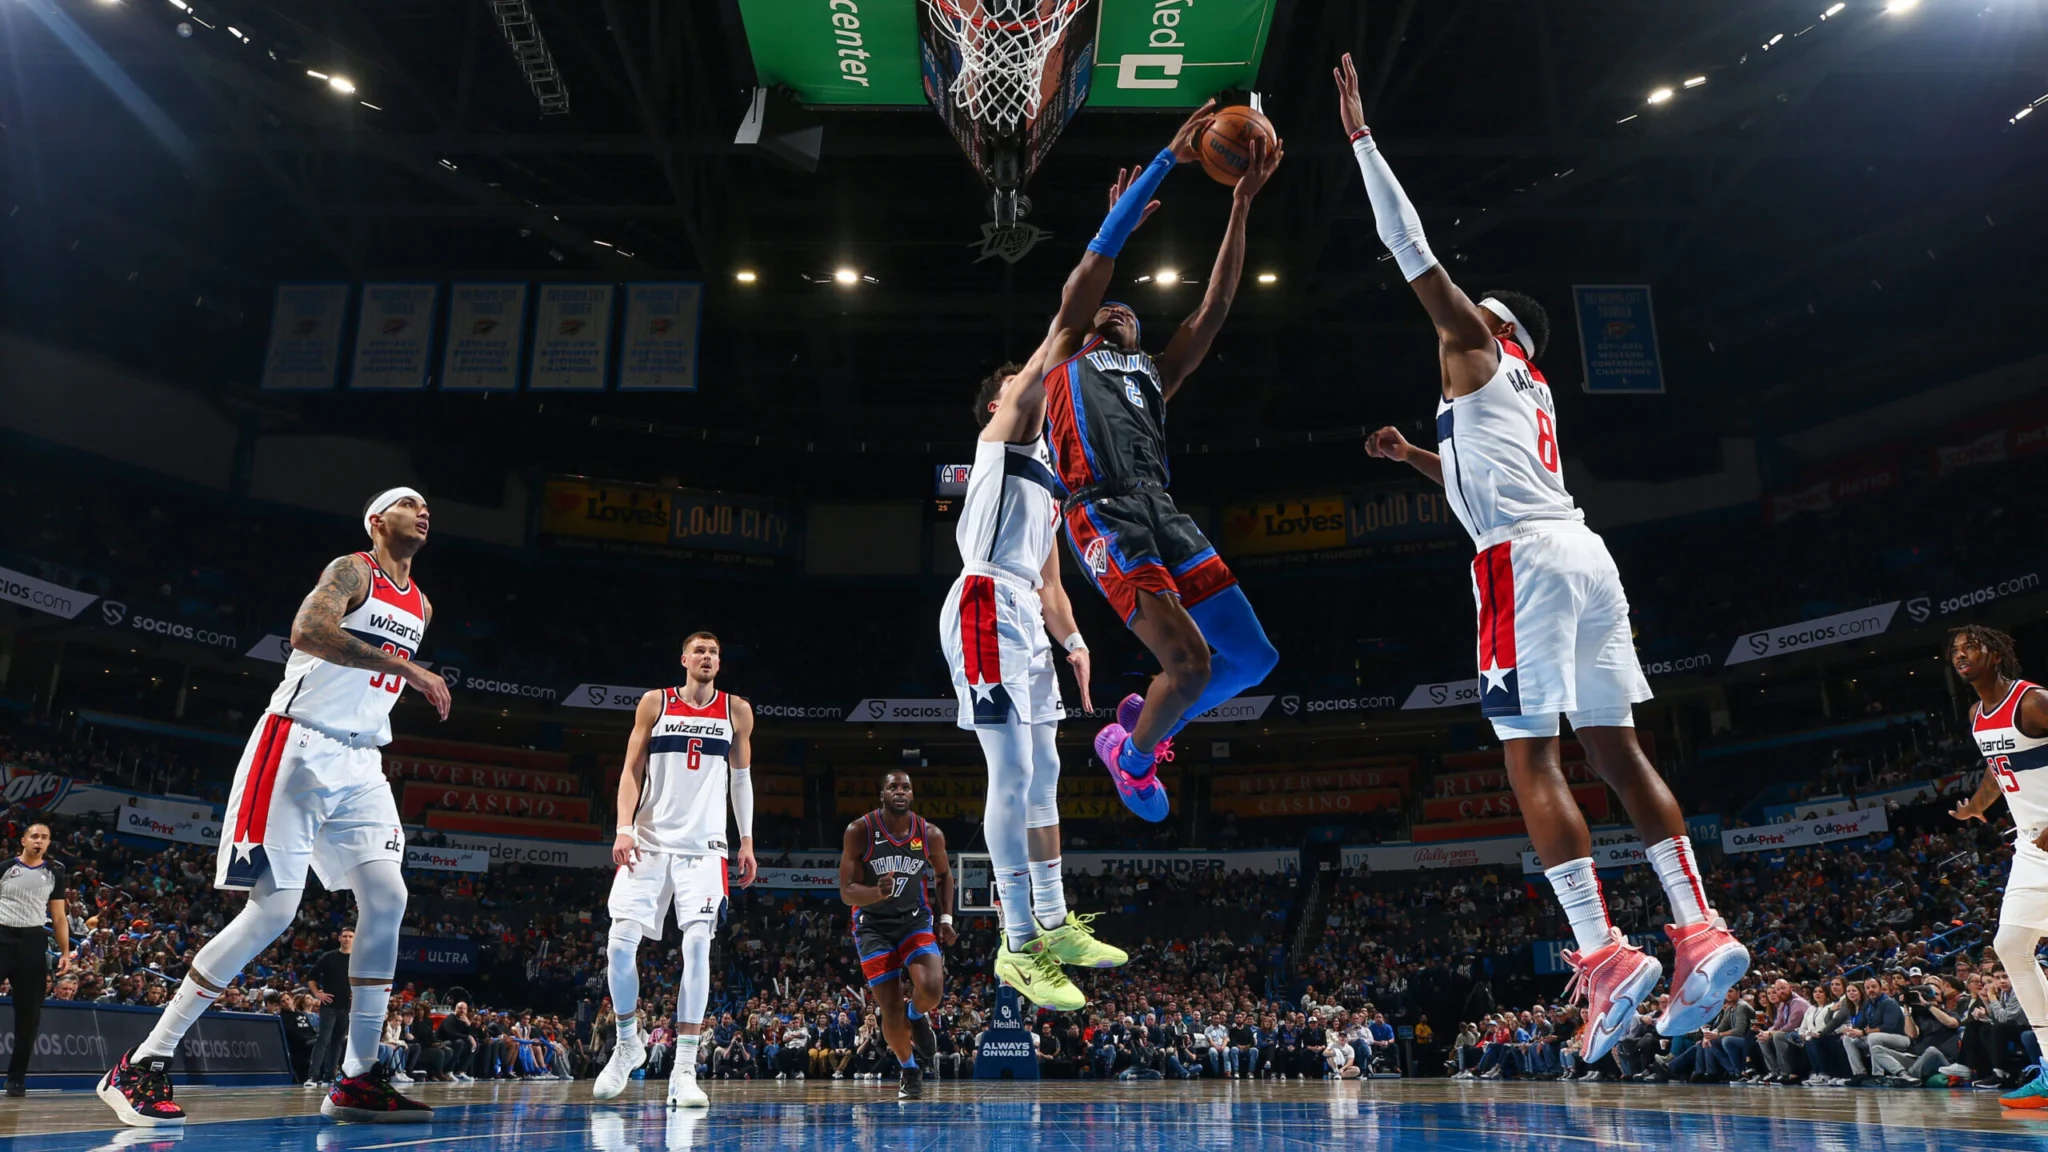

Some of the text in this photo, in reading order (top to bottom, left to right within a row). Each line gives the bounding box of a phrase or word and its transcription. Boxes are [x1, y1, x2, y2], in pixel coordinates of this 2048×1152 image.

[829, 0, 871, 87] center
[1123, 375, 1144, 409] 2
[1536, 408, 1558, 473] 8
[1417, 493, 1449, 525] CIT
[370, 613, 422, 645] wizards
[665, 720, 724, 737] wizards
[1980, 734, 2016, 752] zards
[687, 738, 703, 770] 6
[388, 759, 572, 796] RIVERWIND
[1240, 772, 1382, 793] RIVERWIND
[443, 790, 556, 817] CASINO
[1259, 795, 1351, 813] CASINO
[1458, 796, 1512, 818] CAS
[1692, 823, 1717, 842] 102
[1814, 821, 1859, 836] QuikPrint
[1733, 832, 1785, 846] QuikPrint
[408, 851, 457, 866] QuikPrint
[1610, 849, 1647, 860] QuikPri
[1102, 858, 1226, 873] THUNDER
[790, 873, 834, 885] QuikPrint
[428, 951, 469, 964] ULTRA
[993, 1019, 1020, 1029] Health
[982, 1041, 1030, 1050] ALWAYS
